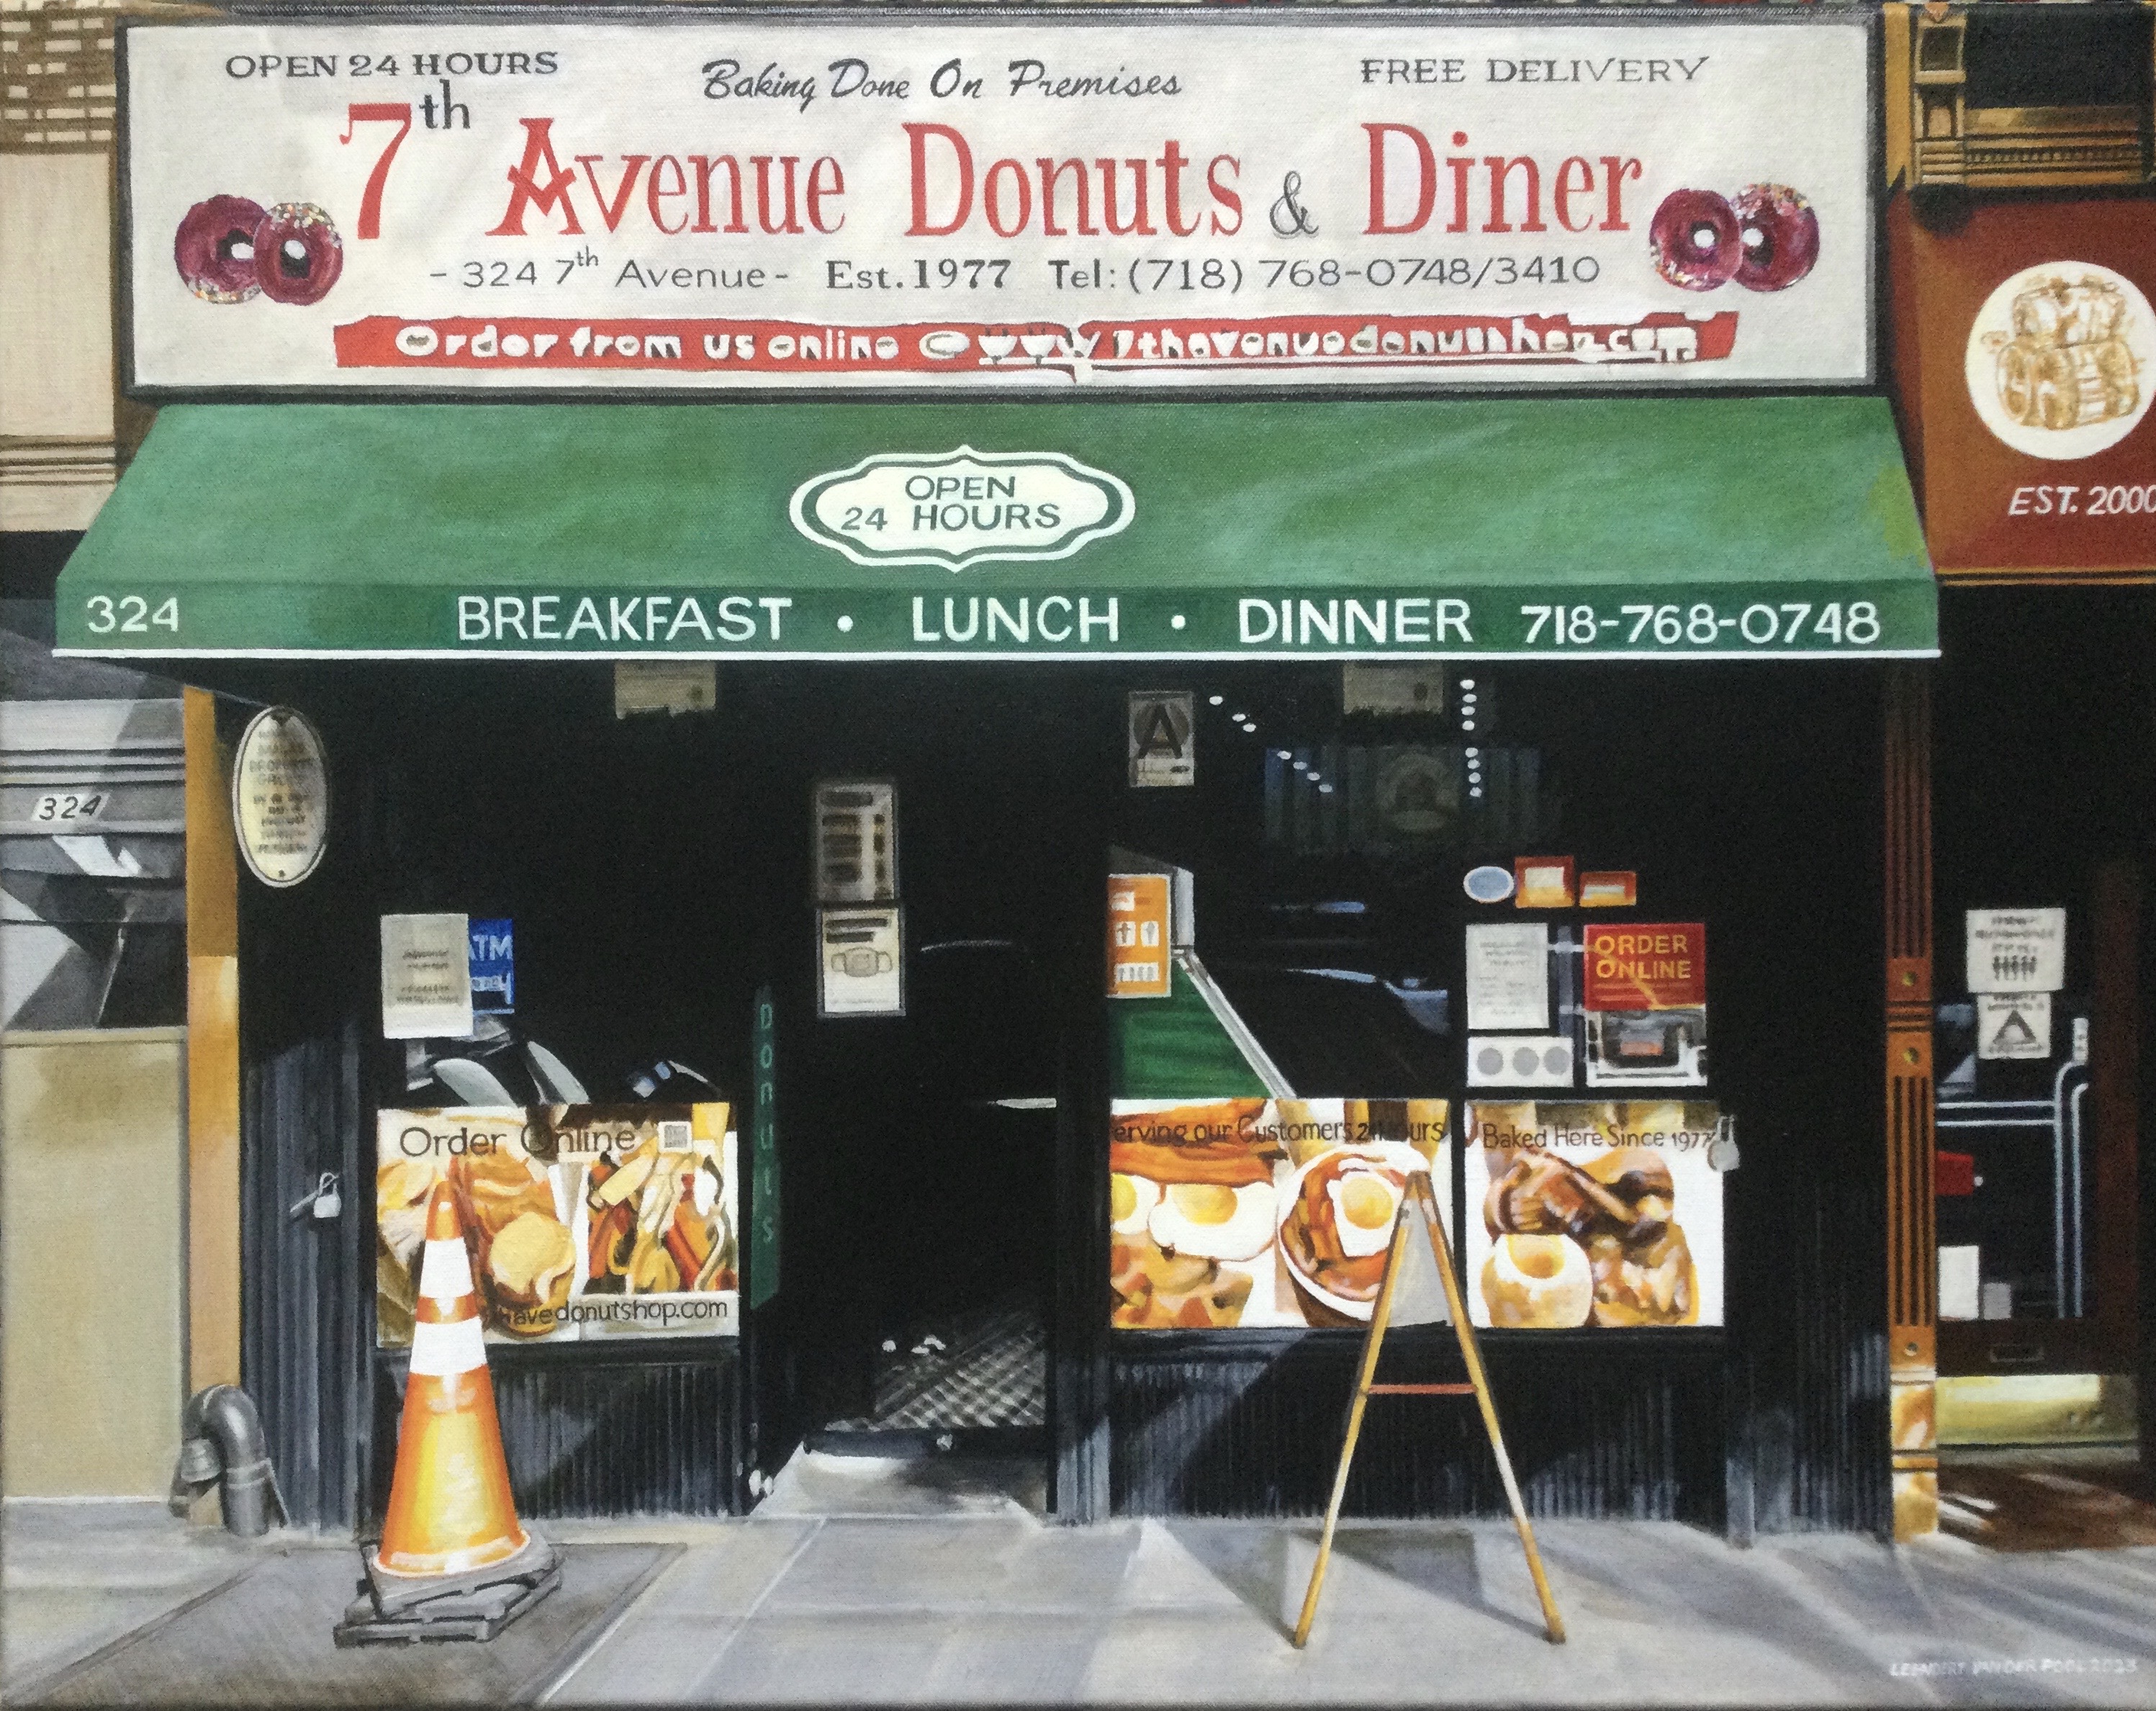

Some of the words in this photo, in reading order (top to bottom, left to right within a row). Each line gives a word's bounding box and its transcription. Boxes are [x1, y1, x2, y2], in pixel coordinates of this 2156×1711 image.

[225, 55, 337, 78] OPEN
[349, 54, 400, 76] 24
[412, 51, 559, 75] HOURS
[1361, 58, 1465, 84] FREE
[1487, 56, 1710, 83] DELIVERY
[701, 58, 816, 114] Baking
[828, 58, 910, 99] Done
[929, 58, 983, 99] On
[1007, 59, 1182, 99] Premises
[485, 117, 845, 236] Avenue
[901, 122, 1242, 238] Donuts
[1269, 171, 1319, 239] &
[1361, 122, 1643, 236] Diner
[463, 261, 537, 289] 324
[555, 245, 599, 285] 7th
[1258, 256, 1600, 289] 768-0748/3410
[905, 475, 1016, 500] OPEN
[2008, 485, 2078, 515] EST.
[2087, 485, 2156, 515] 2000
[841, 507, 888, 531] 24
[912, 503, 1061, 532] HOURS
[86, 595, 179, 633] 324
[457, 594, 793, 642] BREAKFAST
[912, 595, 1119, 643] LUNCH
[1238, 597, 1474, 645] DINNER
[1520, 600, 1881, 645] 718-768-0748
[38, 794, 102, 821] 324
[1595, 934, 1687, 955] ORDER
[1595, 959, 1692, 980] ONLINE
[400, 1127, 507, 1157] Order
[520, 1124, 636, 1153] Online
[1193, 1121, 1233, 1142] our
[1237, 1114, 1353, 1144] Customers
[1482, 1122, 1548, 1150] Baked
[1553, 1123, 1604, 1147] Here
[1607, 1124, 1665, 1148] Since
